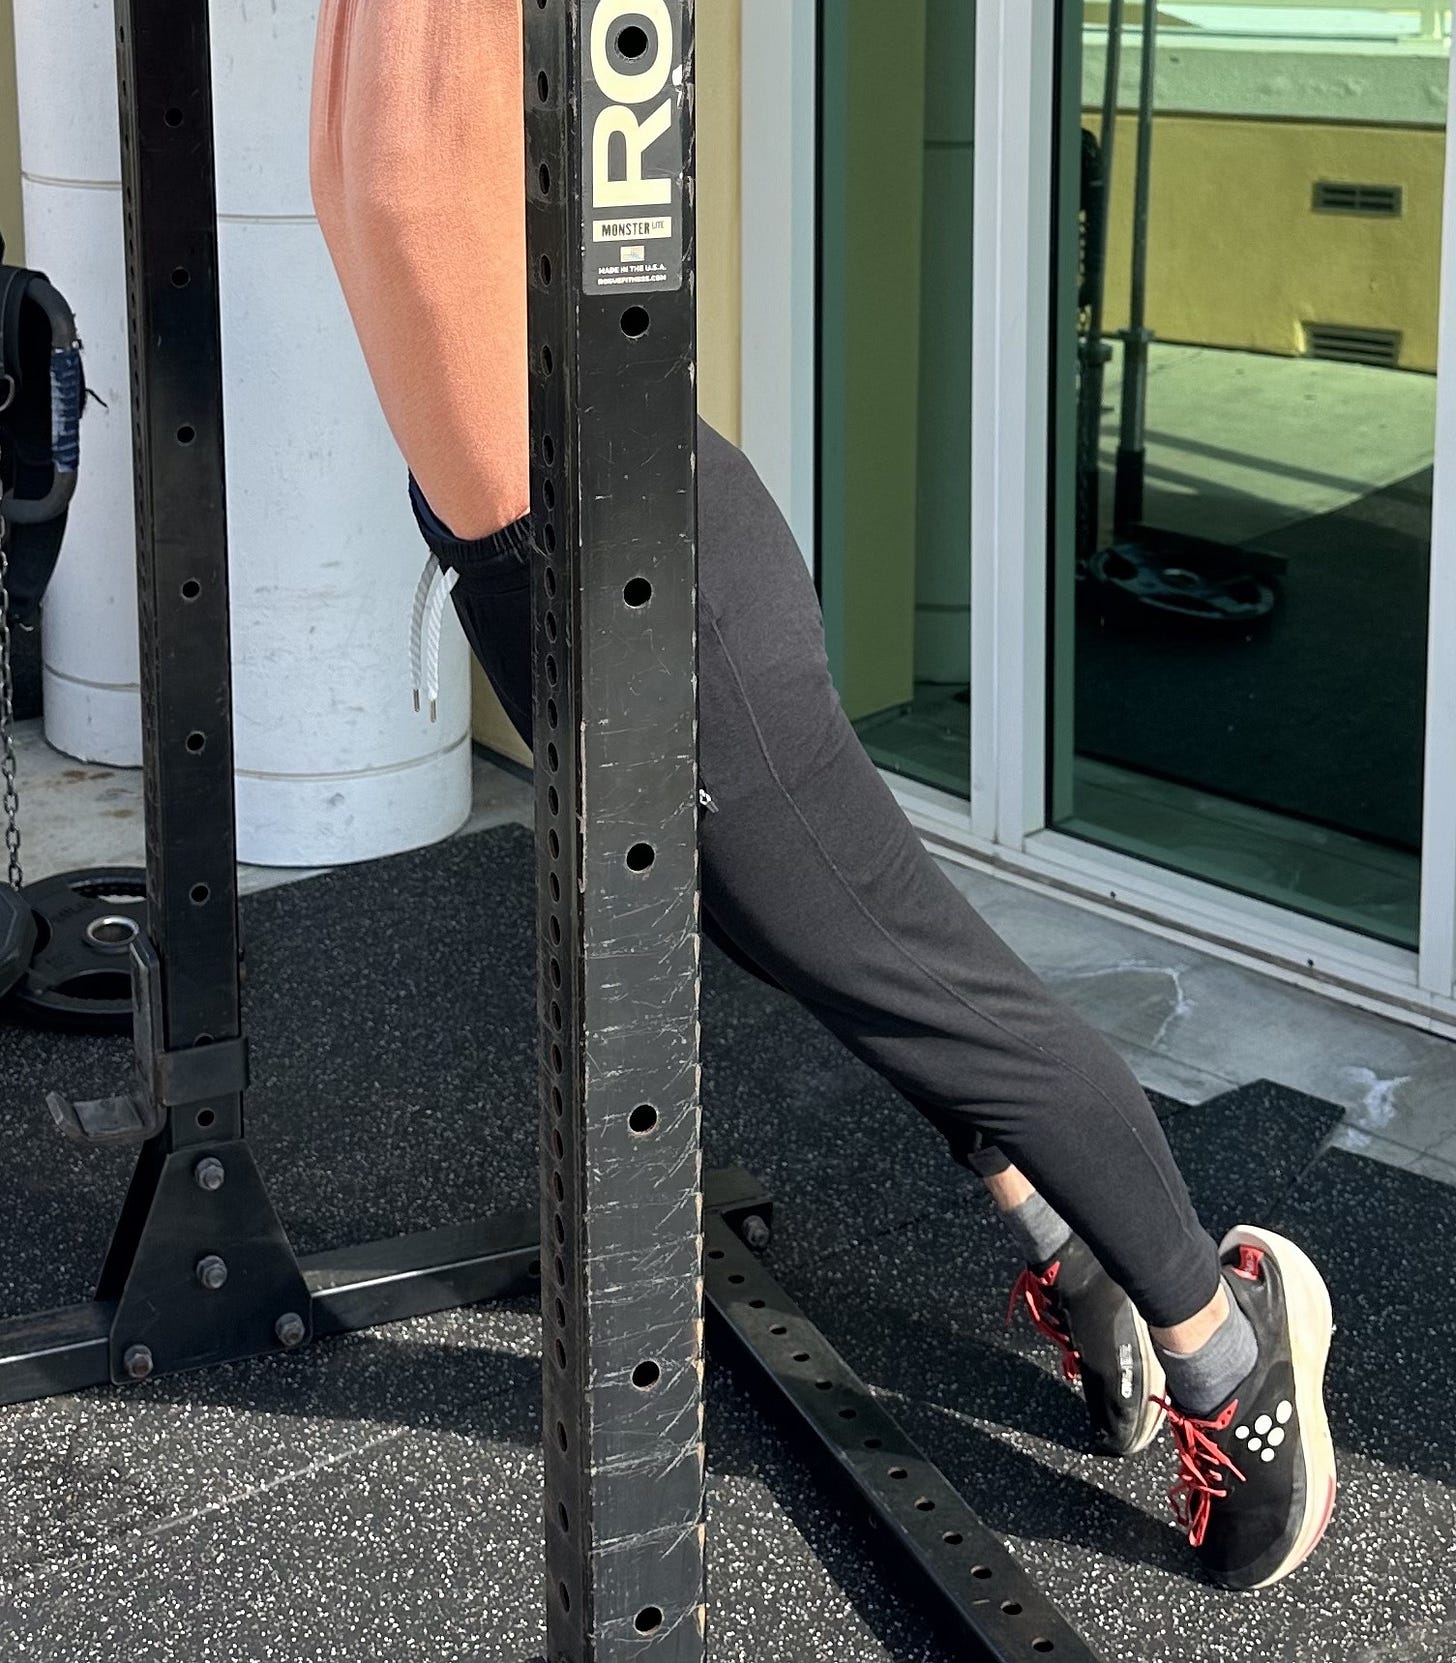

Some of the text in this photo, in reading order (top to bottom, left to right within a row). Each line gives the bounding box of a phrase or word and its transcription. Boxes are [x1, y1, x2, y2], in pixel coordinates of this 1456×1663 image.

[602, 221, 664, 237] MONSTER LITE
[629, 265, 644, 273] THE
[645, 263, 667, 272] U.S.A.
